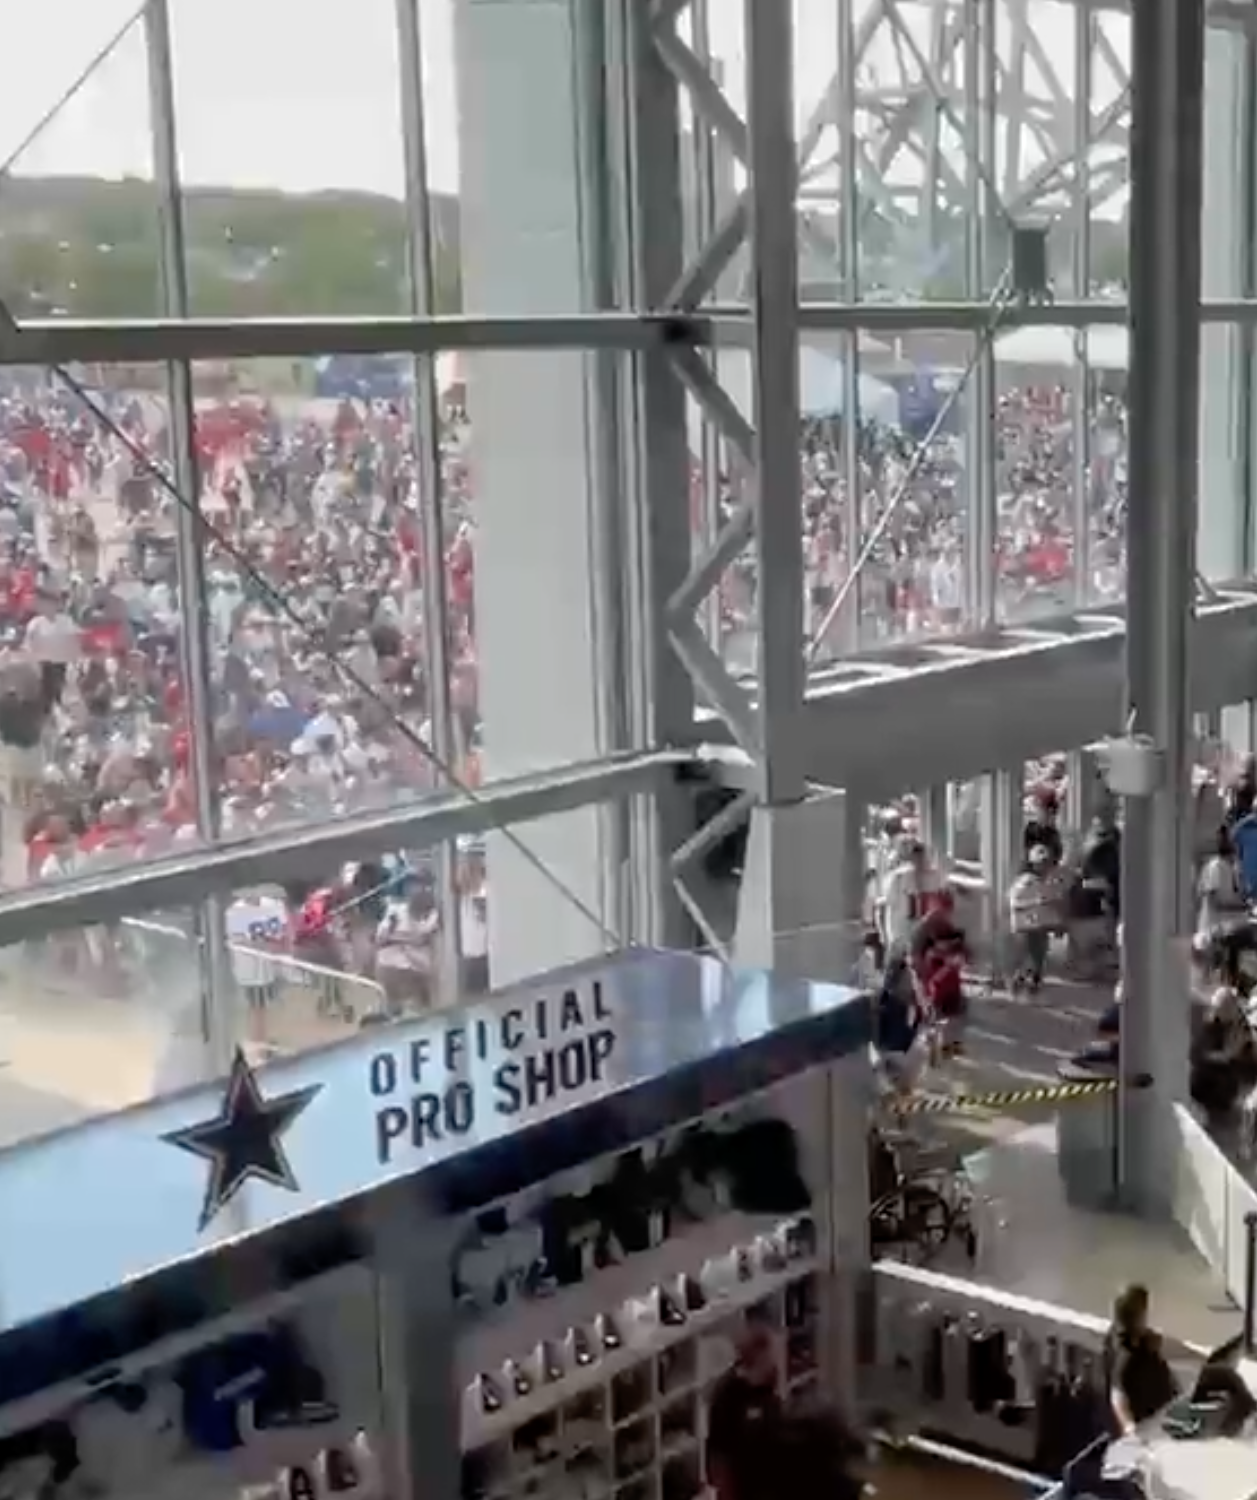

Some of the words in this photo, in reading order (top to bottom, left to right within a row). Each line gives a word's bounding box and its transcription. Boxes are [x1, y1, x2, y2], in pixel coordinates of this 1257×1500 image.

[369, 981, 612, 1096] OFFICIAL
[376, 1080, 476, 1165] PRO
[494, 1029, 616, 1116] SHOP
